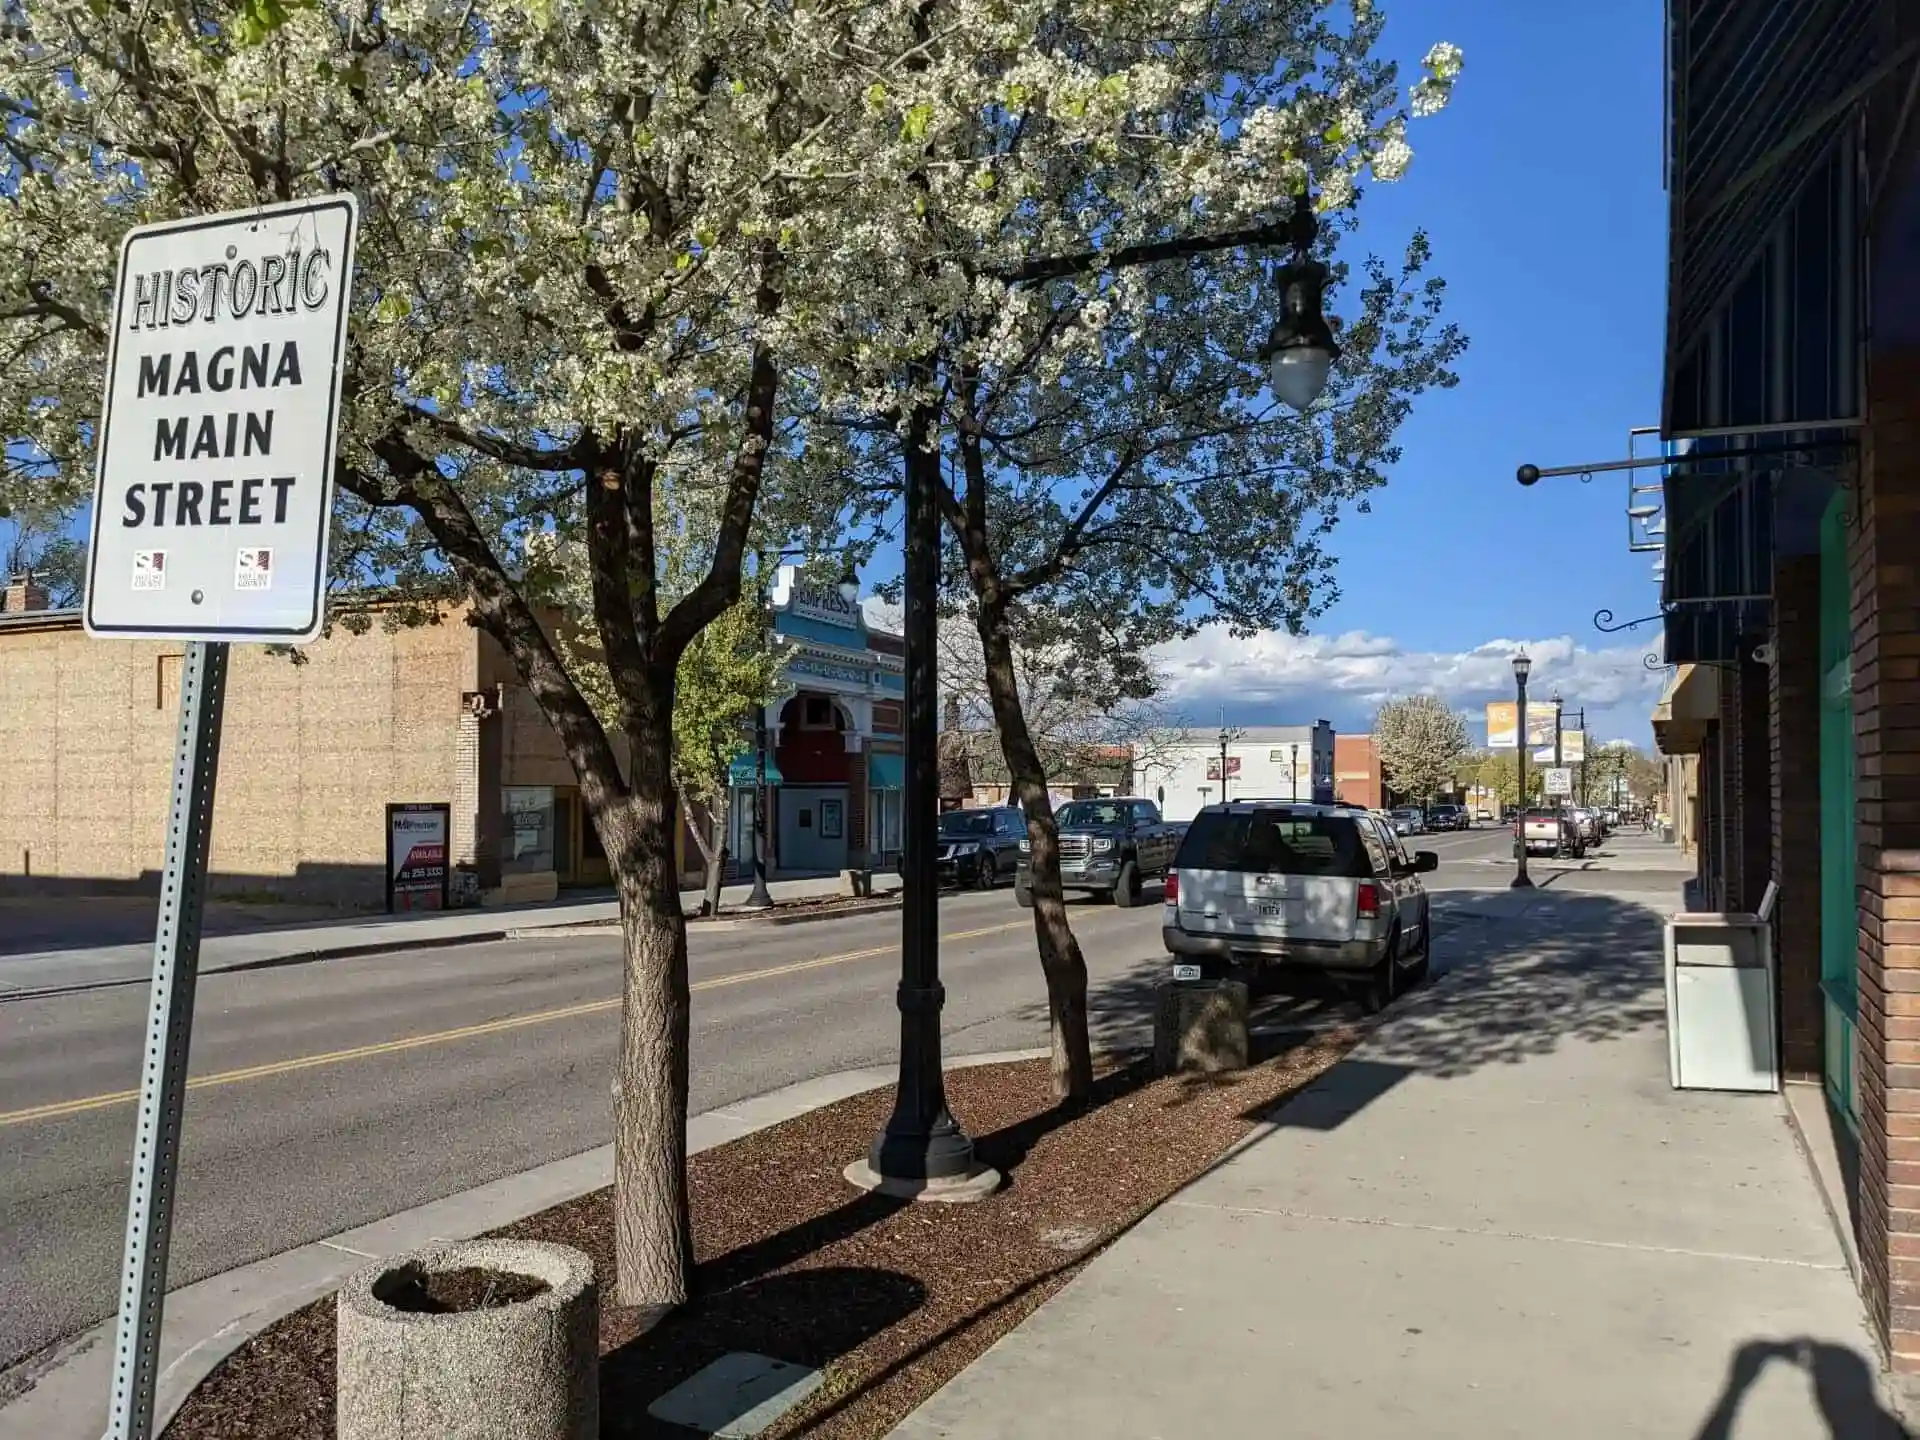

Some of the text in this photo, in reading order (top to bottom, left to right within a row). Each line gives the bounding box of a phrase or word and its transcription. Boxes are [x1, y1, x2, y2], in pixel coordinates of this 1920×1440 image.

[130, 248, 331, 332] HISTORIC
[137, 341, 303, 398] MAGNA
[153, 410, 274, 461] MAIN
[122, 476, 297, 528] STREET
